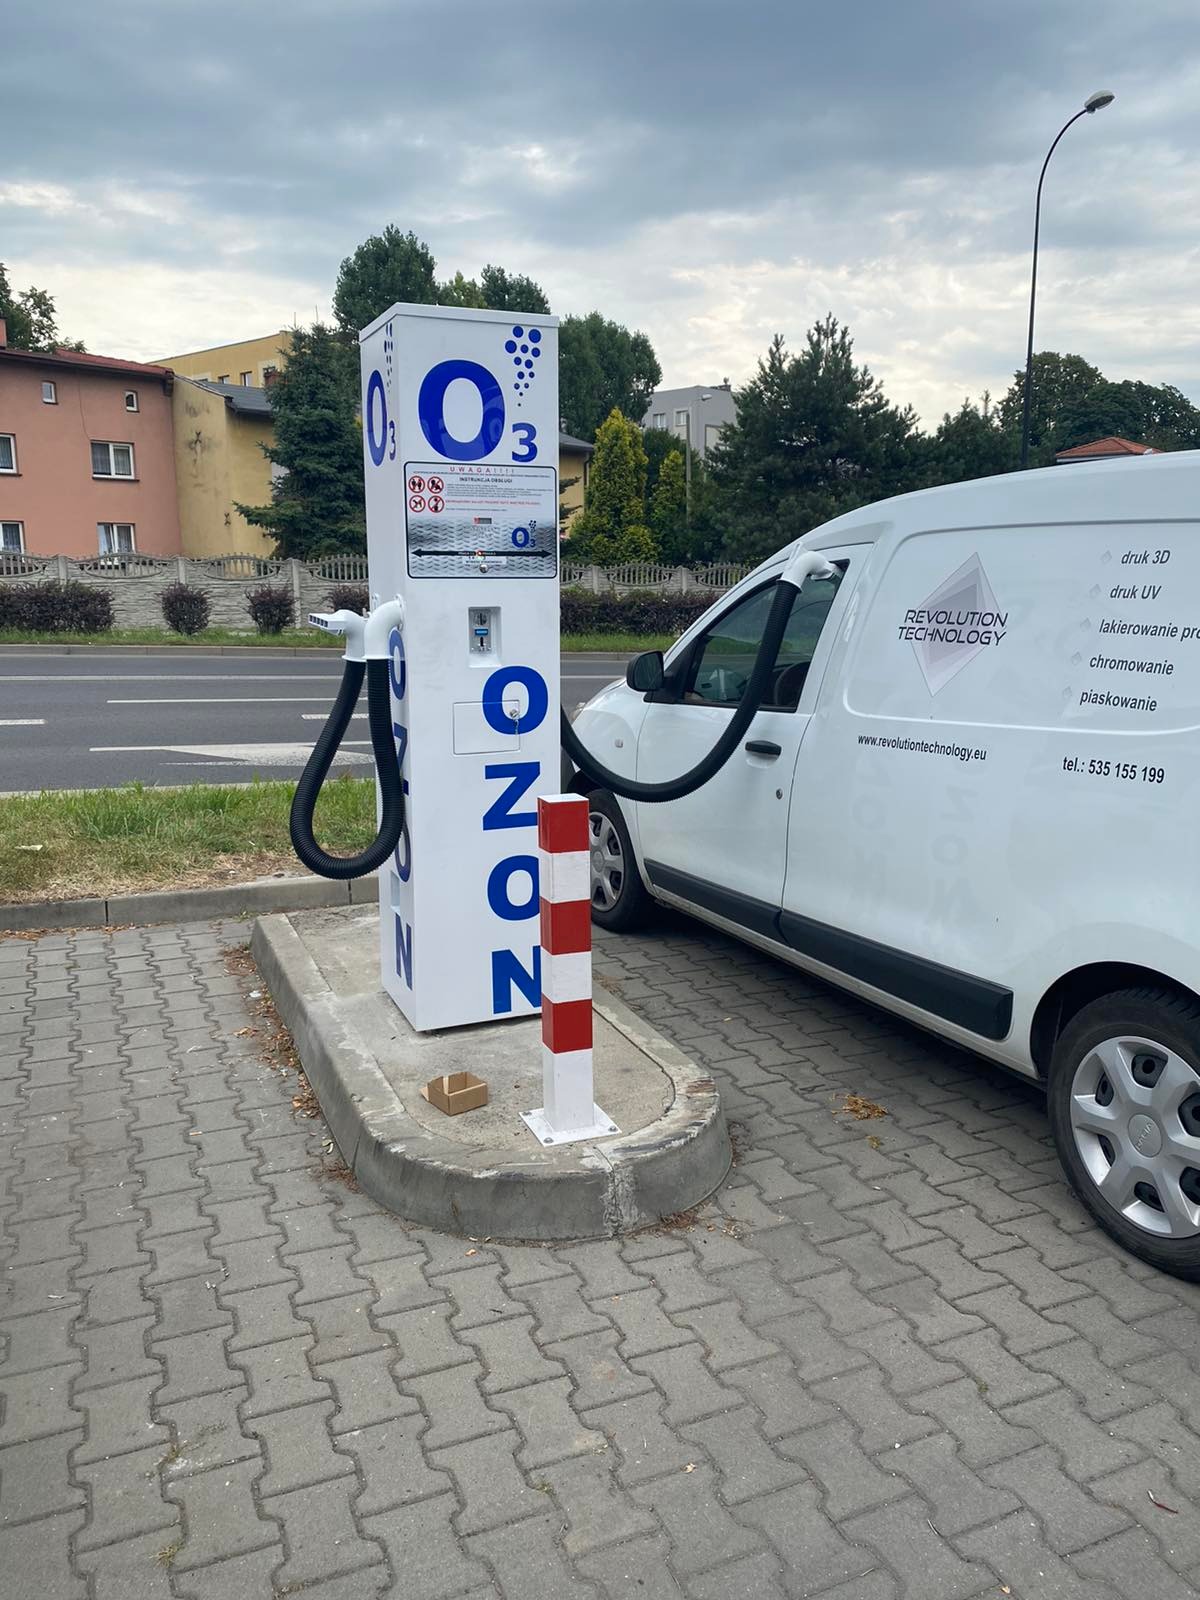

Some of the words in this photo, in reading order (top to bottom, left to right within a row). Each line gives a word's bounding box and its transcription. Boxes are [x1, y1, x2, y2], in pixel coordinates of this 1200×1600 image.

[1121, 550, 1149, 565] druk
[1152, 550, 1171, 564] 3D
[1109, 584, 1137, 599] druk
[1141, 585, 1162, 600] UV
[903, 609, 1009, 628] REVOLUTION
[1099, 619, 1178, 638] lakierowanie
[898, 626, 1007, 647] TECHNOLOGY
[1089, 654, 1174, 675] chromowanie
[1079, 689, 1158, 712] piaskowanie
[857, 734, 987, 762] www.revolutiontechnology.eu
[1063, 756, 1085, 773] tel.:
[1088, 759, 1110, 776] 535
[1114, 762, 1137, 780] 155
[1140, 765, 1165, 784] 199
